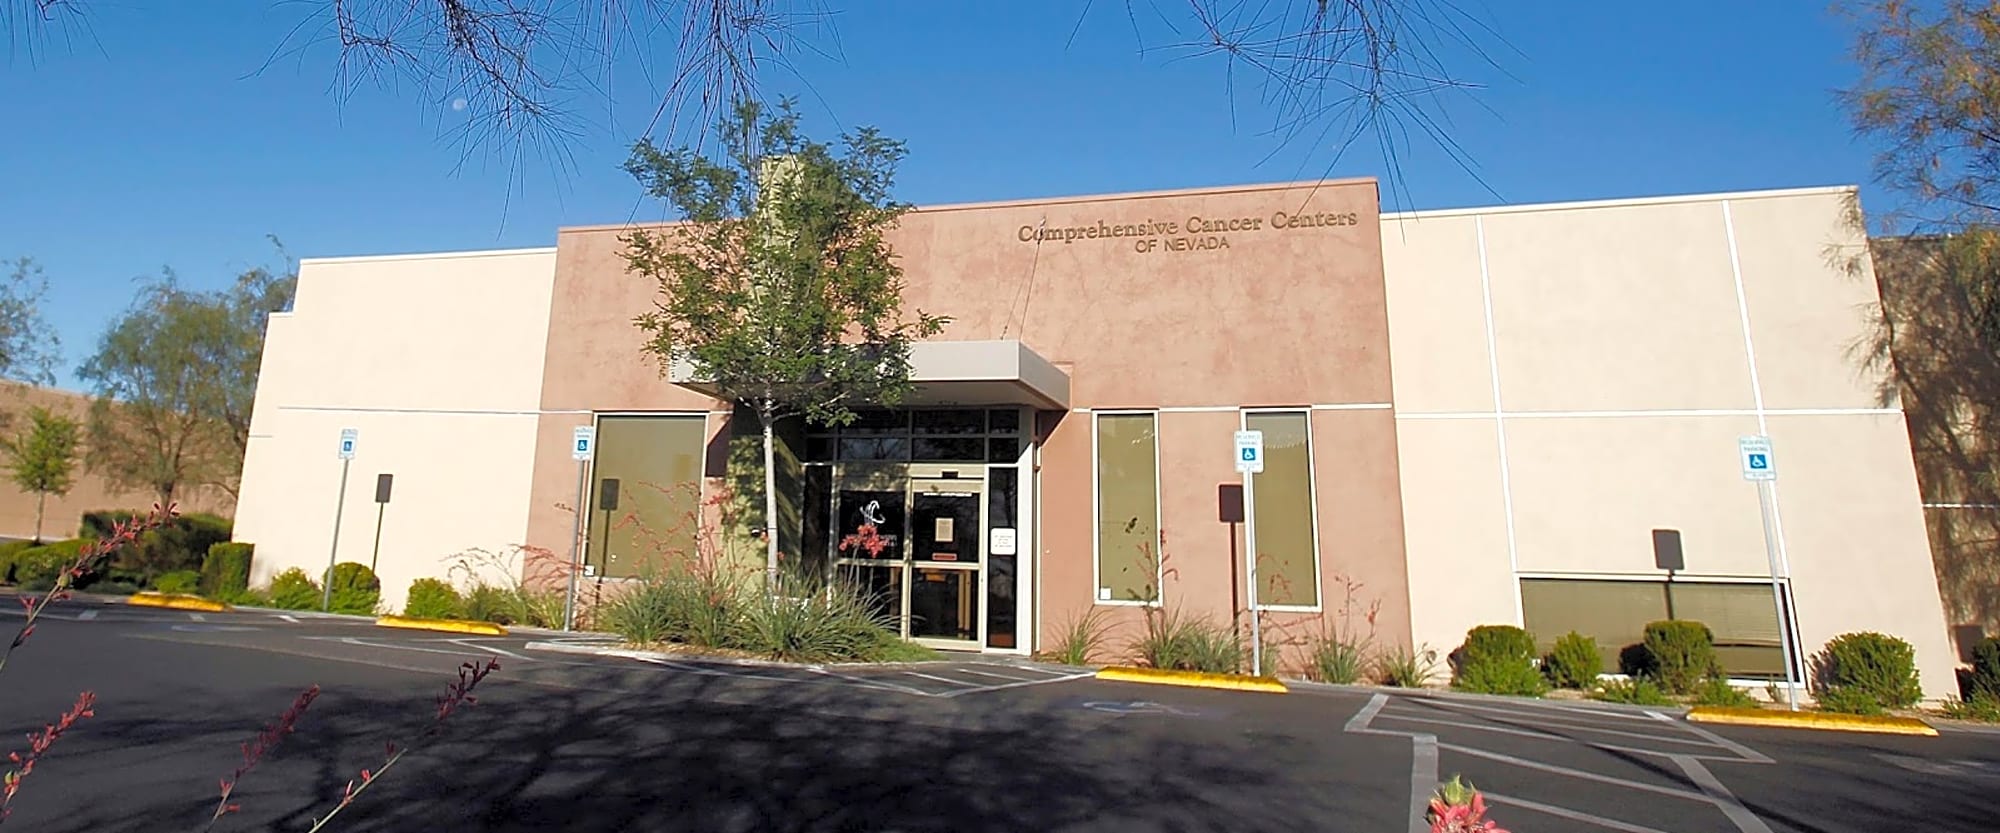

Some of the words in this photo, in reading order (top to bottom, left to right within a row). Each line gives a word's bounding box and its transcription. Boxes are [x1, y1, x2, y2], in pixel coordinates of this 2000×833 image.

[1018, 219, 1179, 244] Comprehensive
[1189, 215, 1263, 233] Cancer
[1270, 210, 1358, 229] Centers
[1135, 239, 1157, 254] OF
[1164, 236, 1230, 252] NEVADA
